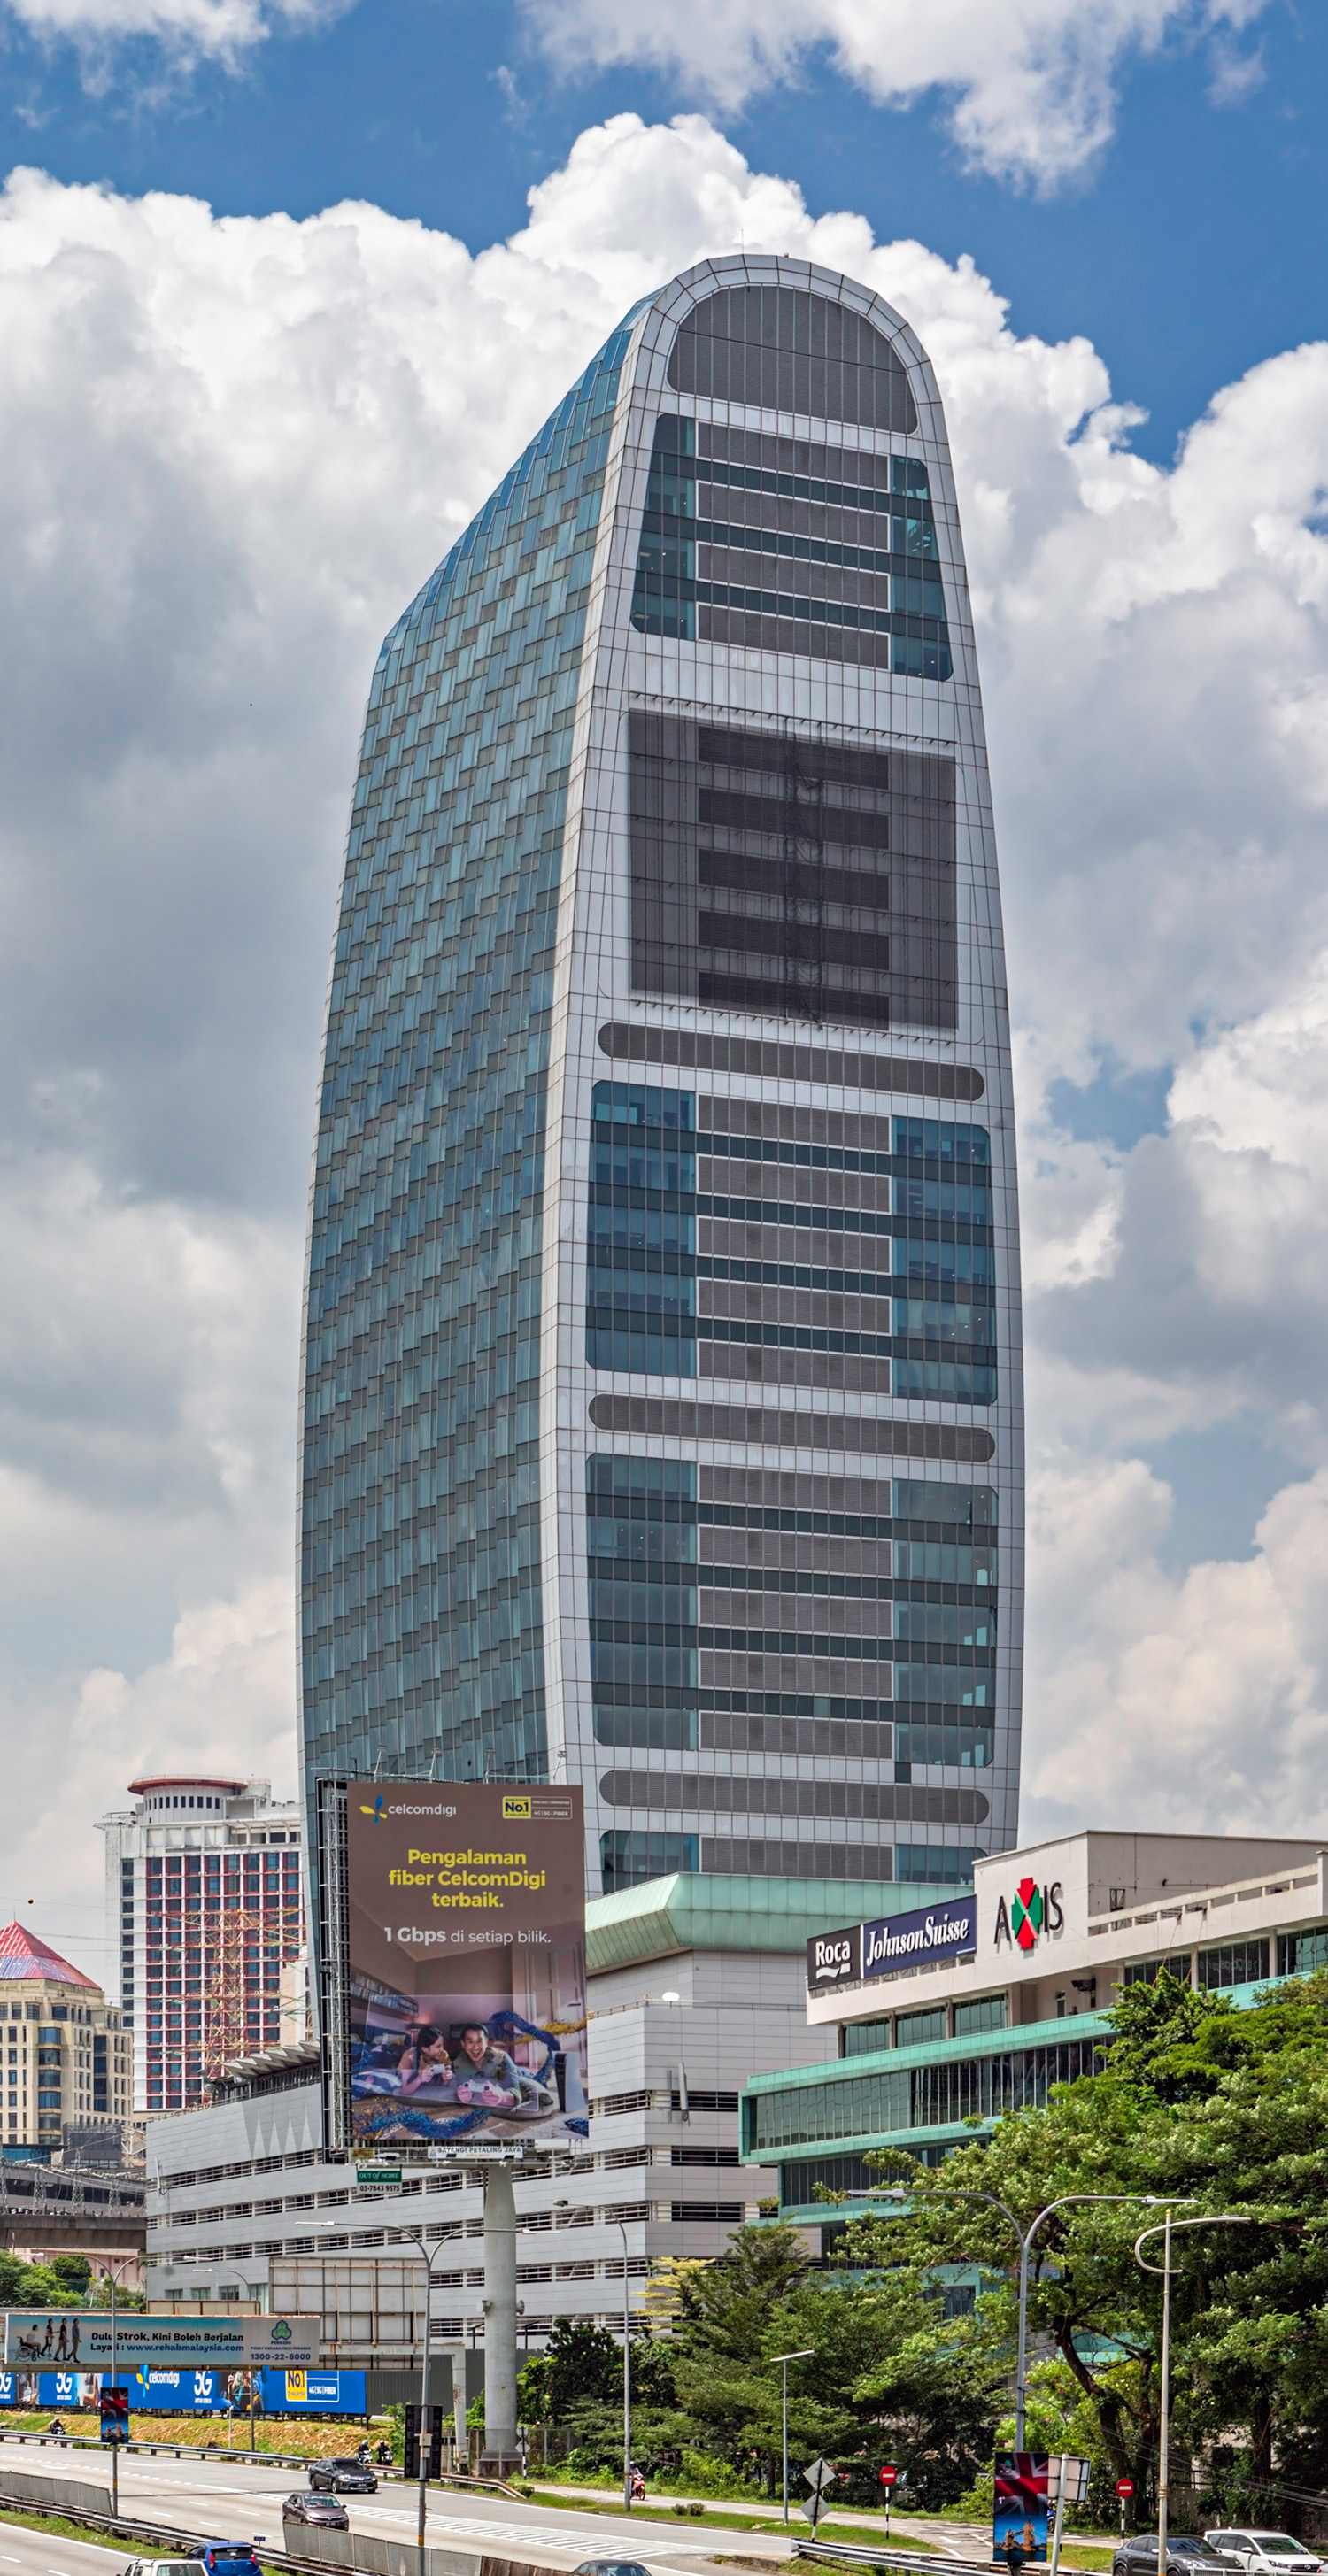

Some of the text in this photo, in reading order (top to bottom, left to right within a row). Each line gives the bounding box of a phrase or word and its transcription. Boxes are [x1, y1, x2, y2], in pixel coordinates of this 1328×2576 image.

[388, 1803, 457, 1817] celcomdigi
[505, 1801, 529, 1812] No.1
[407, 1849, 527, 1868] Pengalaman
[389, 1869, 546, 1890] fiber CelcomDigi
[431, 1891, 504, 1908] terbaik.
[384, 1926, 552, 1946] 1 Gbps di setiap bilik.
[815, 1940, 851, 1967] Roca
[372, 2171, 382, 2180] of
[116, 2332, 150, 2342] Strok,
[152, 2333, 171, 2341] Kini
[174, 2333, 201, 2341] Boleh
[204, 2333, 244, 2343] Berjalan
[90, 2343, 120, 2353] Layai
[127, 2343, 244, 2353] www.rehabmalaysia.com
[149, 2371, 180, 2387] celcomdigi
[194, 2371, 212, 2396] 5G
[288, 2371, 305, 2387] No.1
